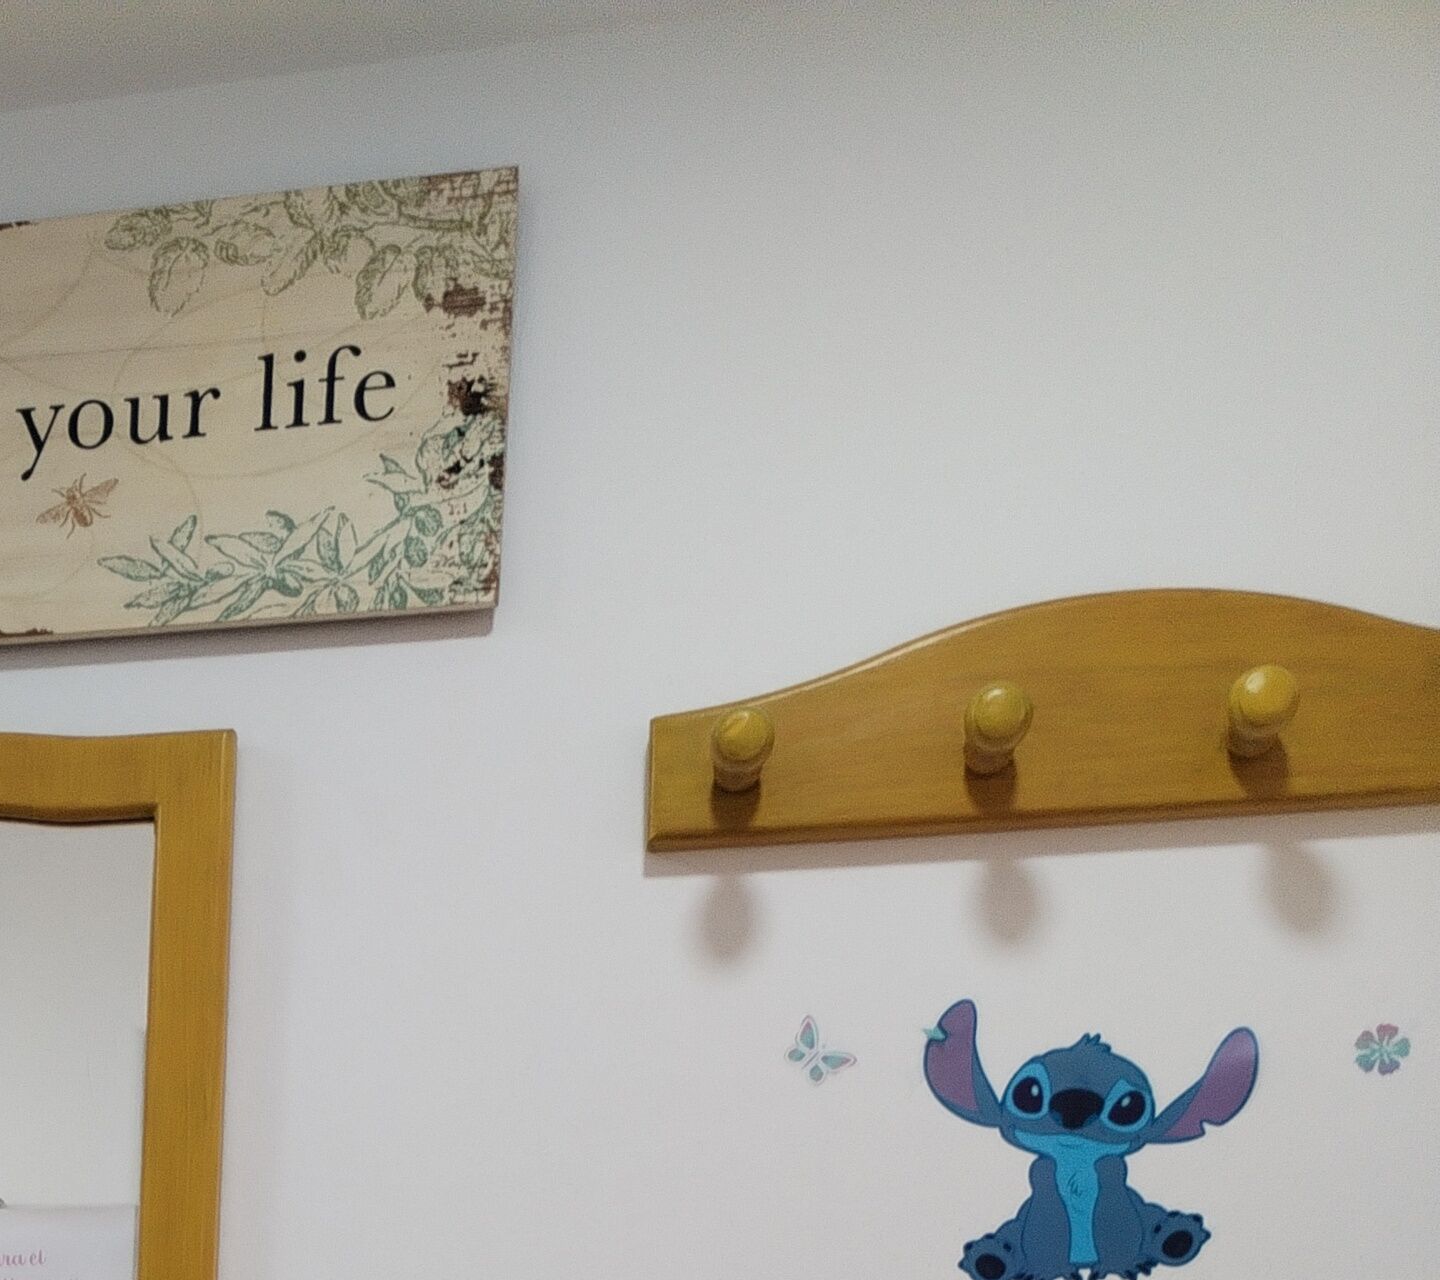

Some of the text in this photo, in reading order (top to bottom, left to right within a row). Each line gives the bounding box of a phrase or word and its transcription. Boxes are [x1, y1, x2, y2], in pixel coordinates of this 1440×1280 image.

[16, 385, 221, 481] your
[253, 343, 397, 432] life
[29, 1249, 46, 1266] el
